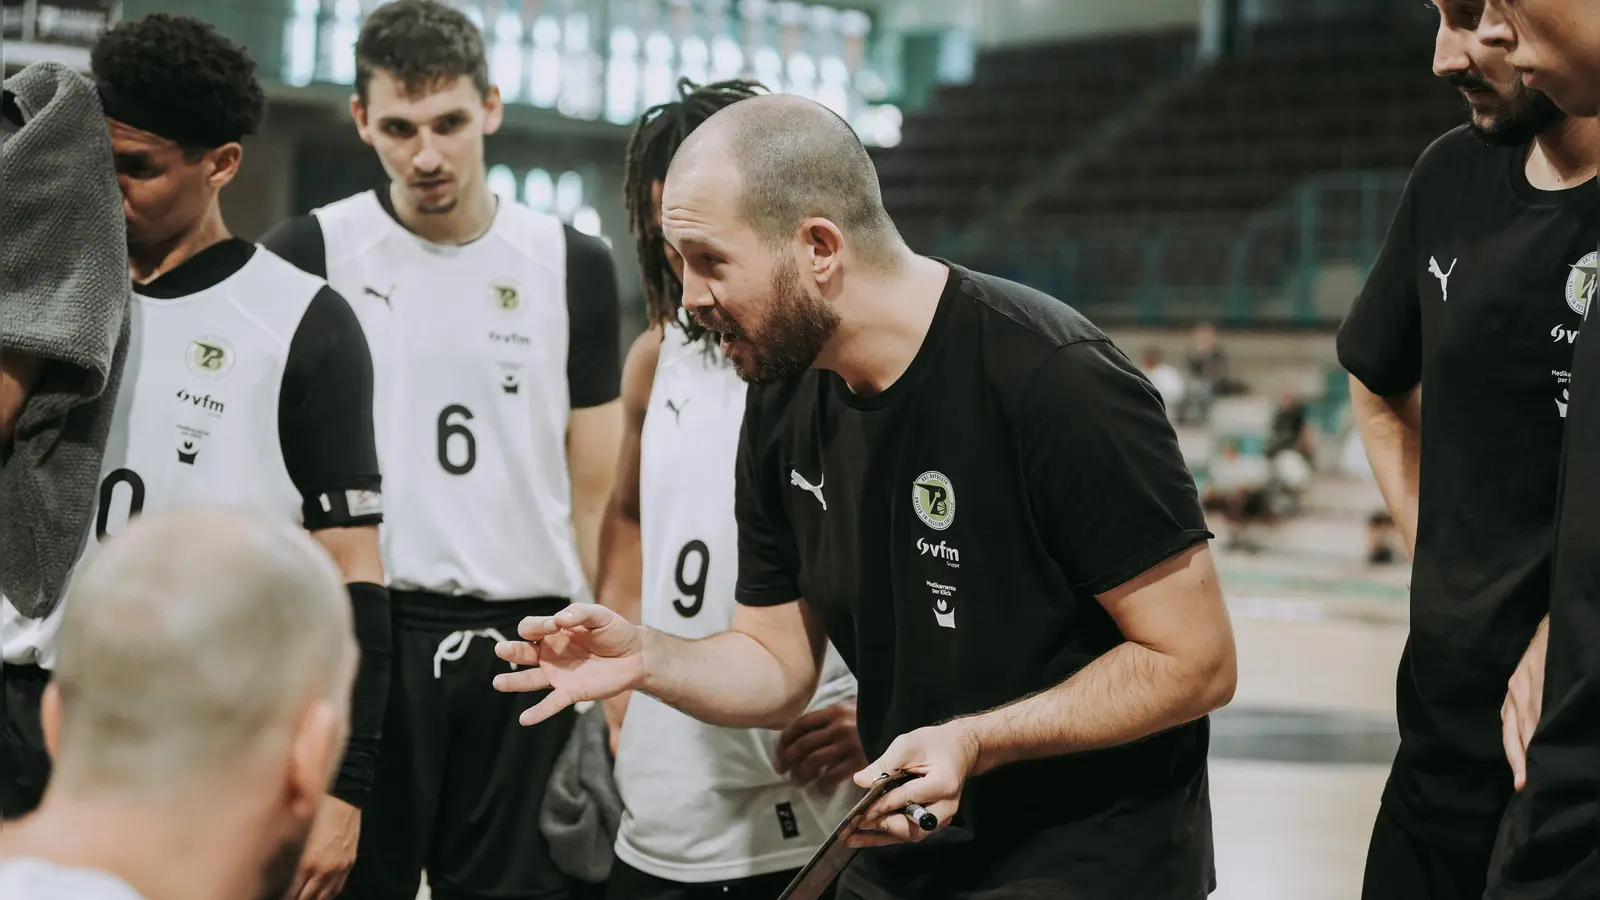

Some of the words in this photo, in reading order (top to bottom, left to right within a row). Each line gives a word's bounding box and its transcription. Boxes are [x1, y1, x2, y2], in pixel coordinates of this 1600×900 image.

[1551, 369, 1572, 378] Medika
[192, 394, 225, 413] vfm
[438, 403, 476, 476] 6
[929, 540, 960, 562] vfm
[672, 539, 710, 618] 9
[925, 579, 957, 592] Medikamente
[940, 589, 952, 597] Klick
